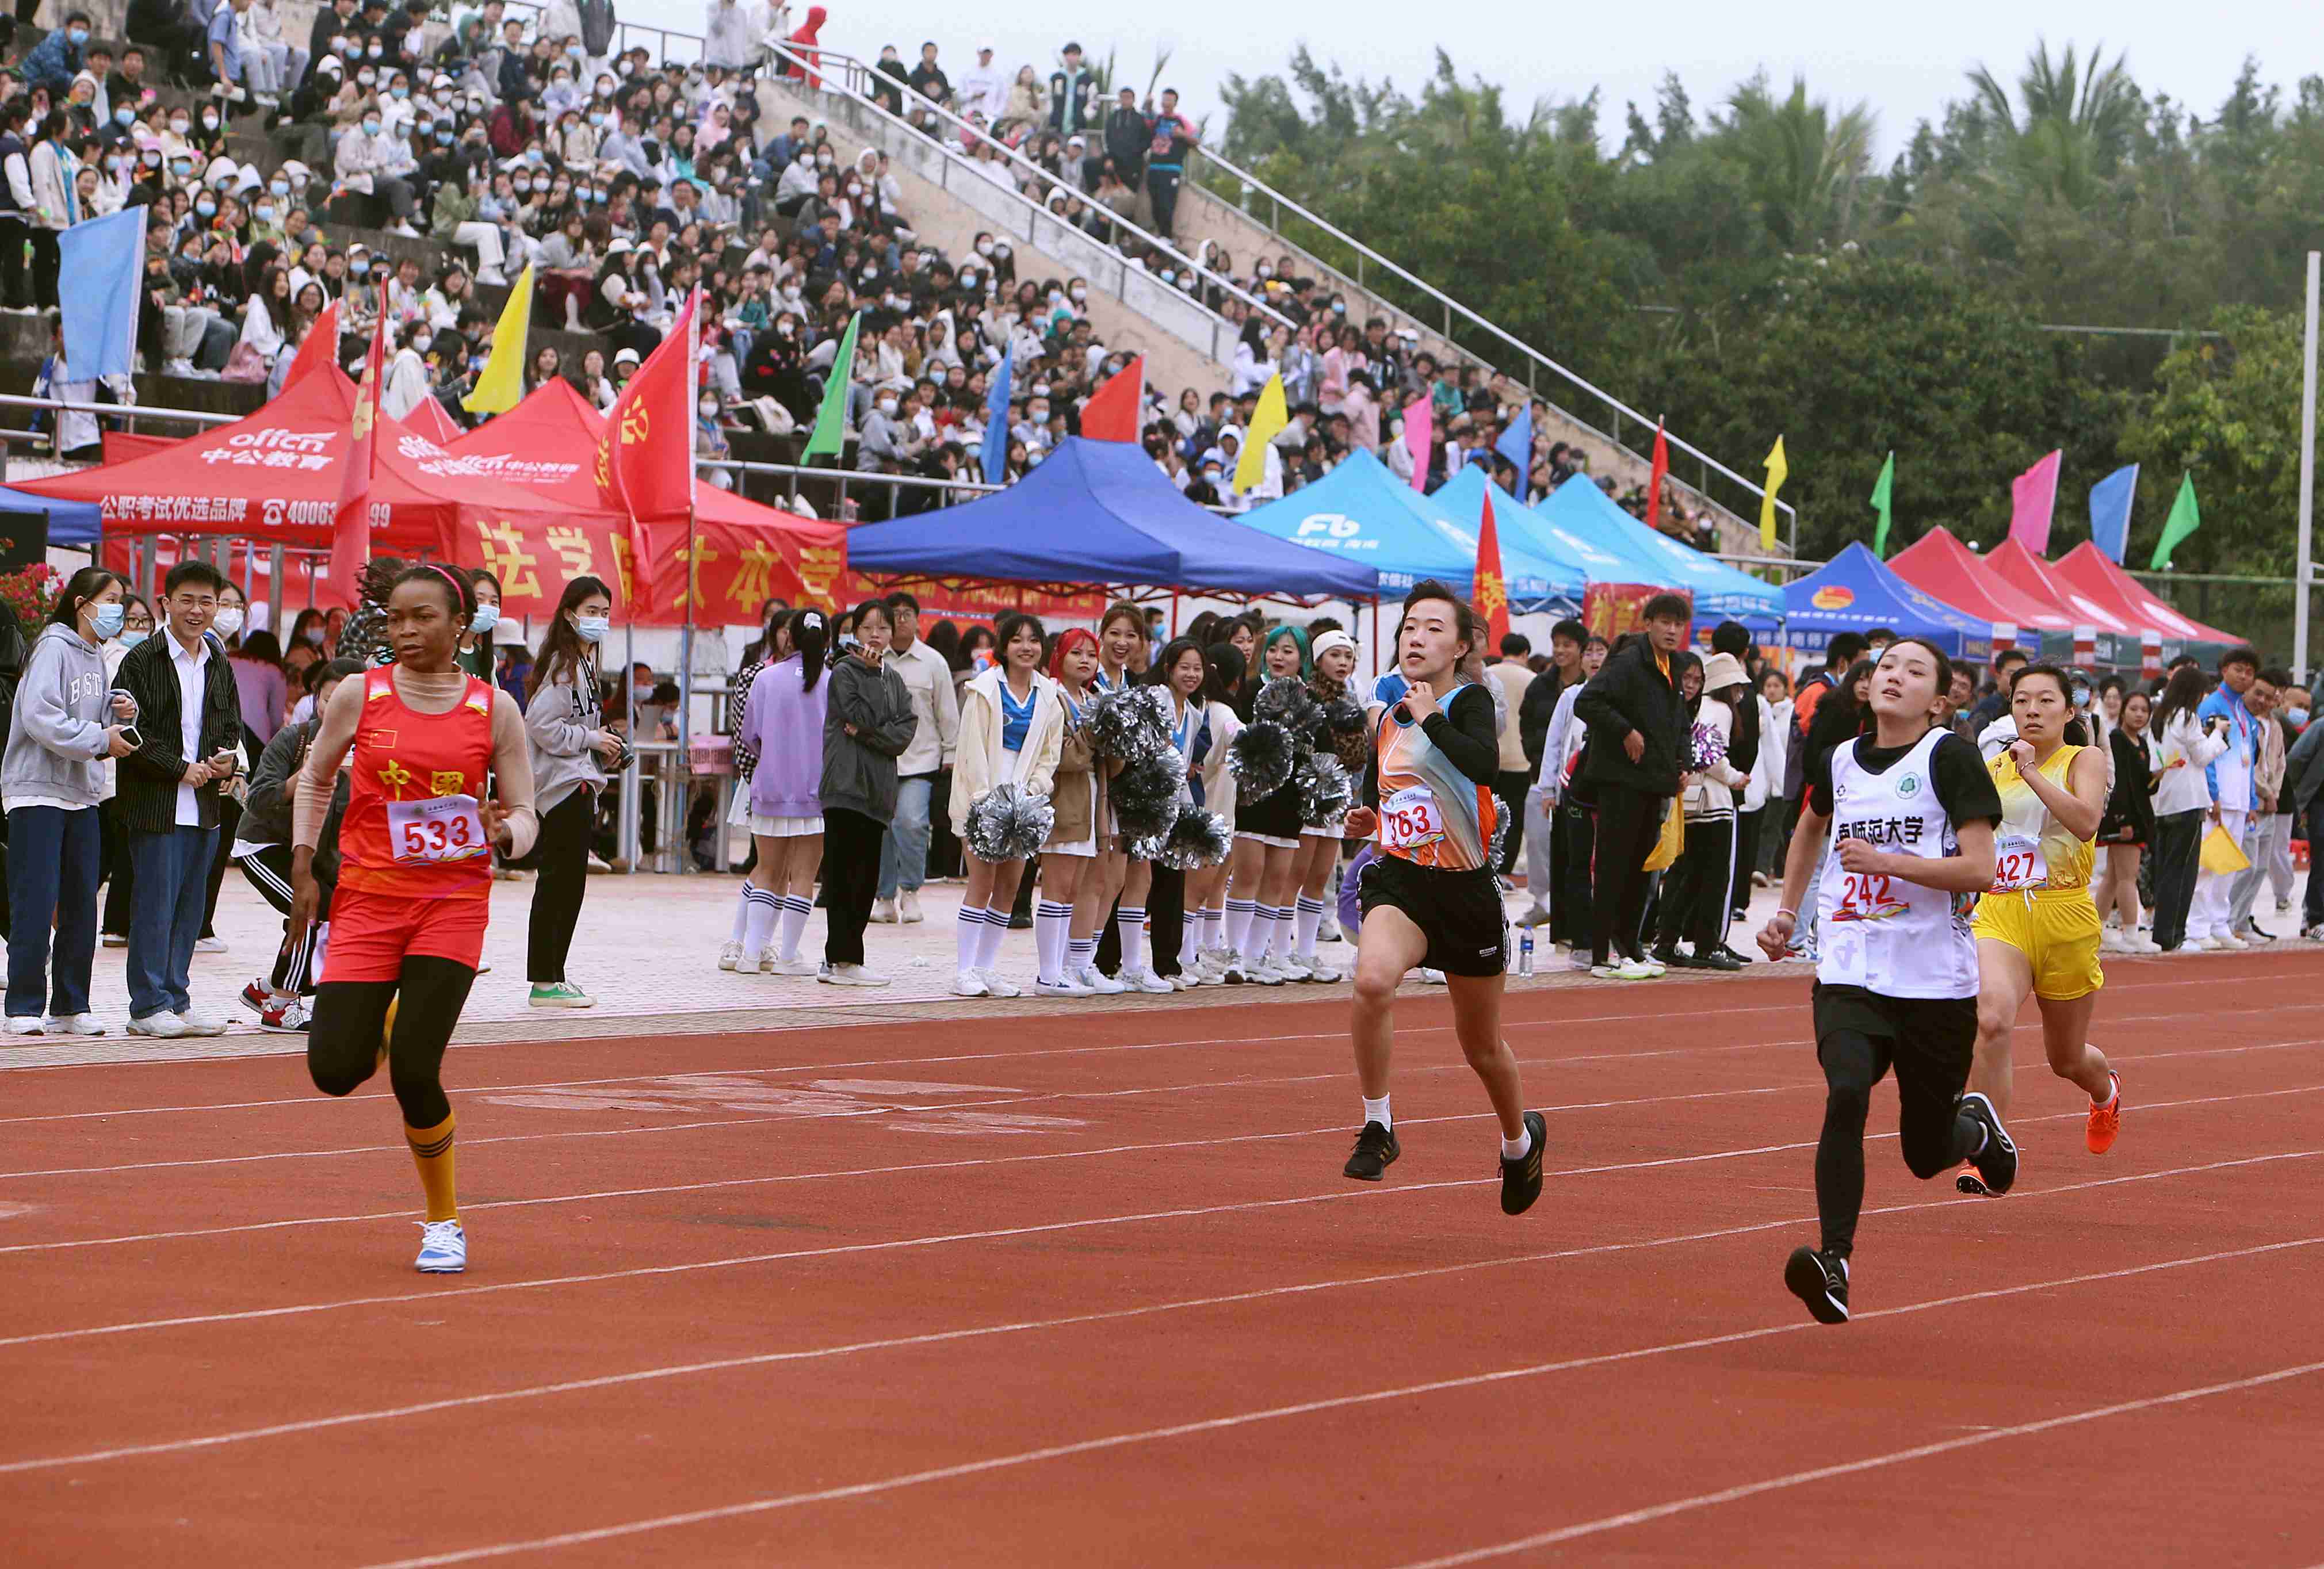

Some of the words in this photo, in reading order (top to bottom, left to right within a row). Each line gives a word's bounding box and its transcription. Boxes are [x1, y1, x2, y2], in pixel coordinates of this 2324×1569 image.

[229, 427, 338, 452] offcn
[201, 447, 334, 470] 中公教育
[100, 494, 249, 522] 公职考试优选品牌
[287, 499, 391, 529] 4006399
[69, 671, 102, 706] BST
[404, 815, 470, 854] 533
[1996, 852, 2035, 882] 427
[1842, 873, 1896, 907] 242
